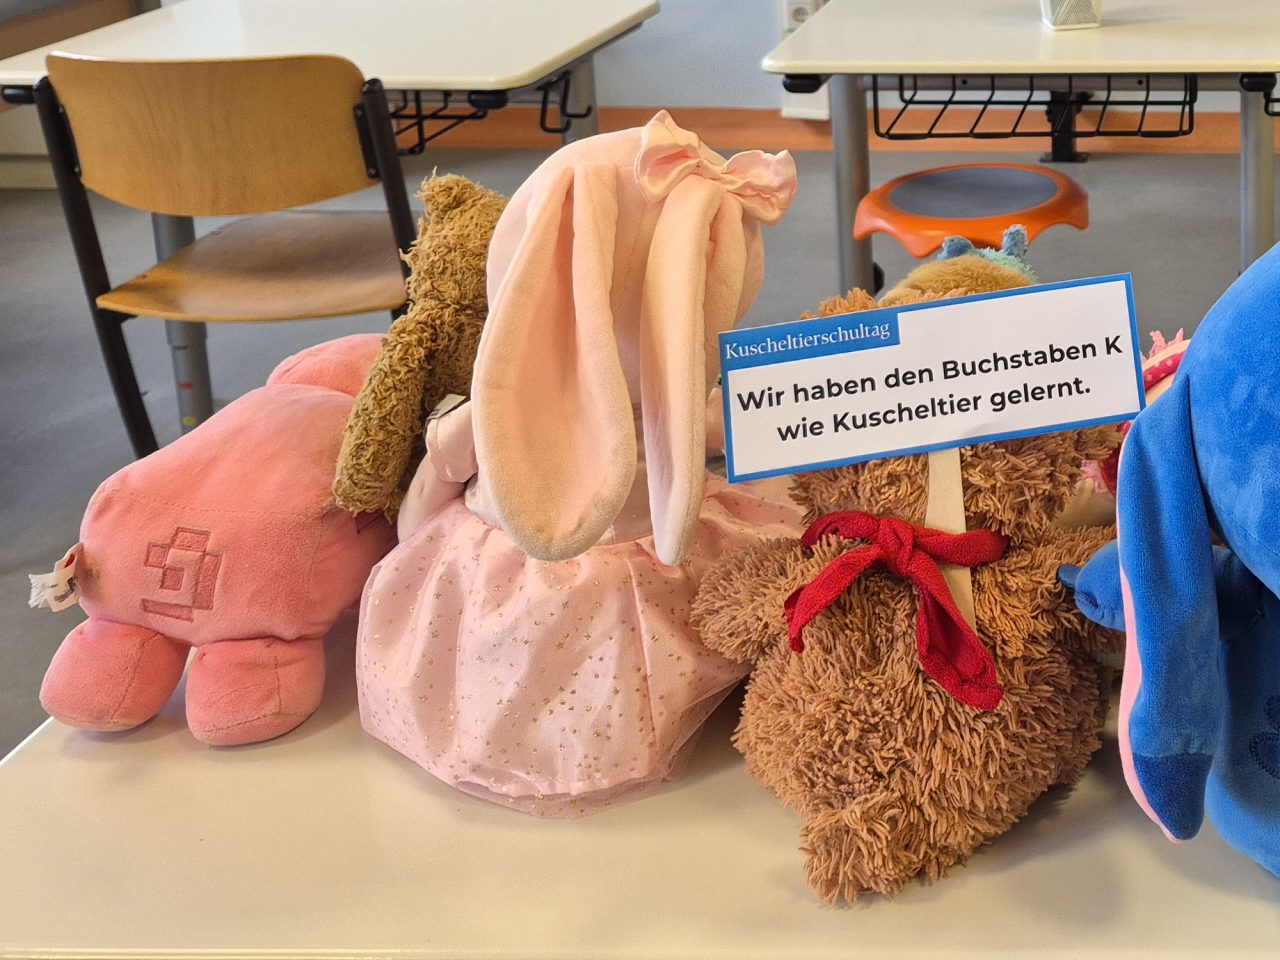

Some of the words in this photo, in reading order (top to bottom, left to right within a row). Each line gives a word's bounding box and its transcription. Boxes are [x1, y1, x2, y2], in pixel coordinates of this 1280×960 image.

[725, 320, 890, 360] Kuscheltierschultag
[737, 387, 785, 412] Wir
[793, 374, 876, 405] haben
[884, 366, 934, 390] den
[942, 341, 1097, 380] Buchstaben
[1105, 335, 1123, 356] K
[777, 418, 824, 442] wie
[833, 394, 982, 434] Kuscheltier
[990, 375, 1091, 412] gelernt.
